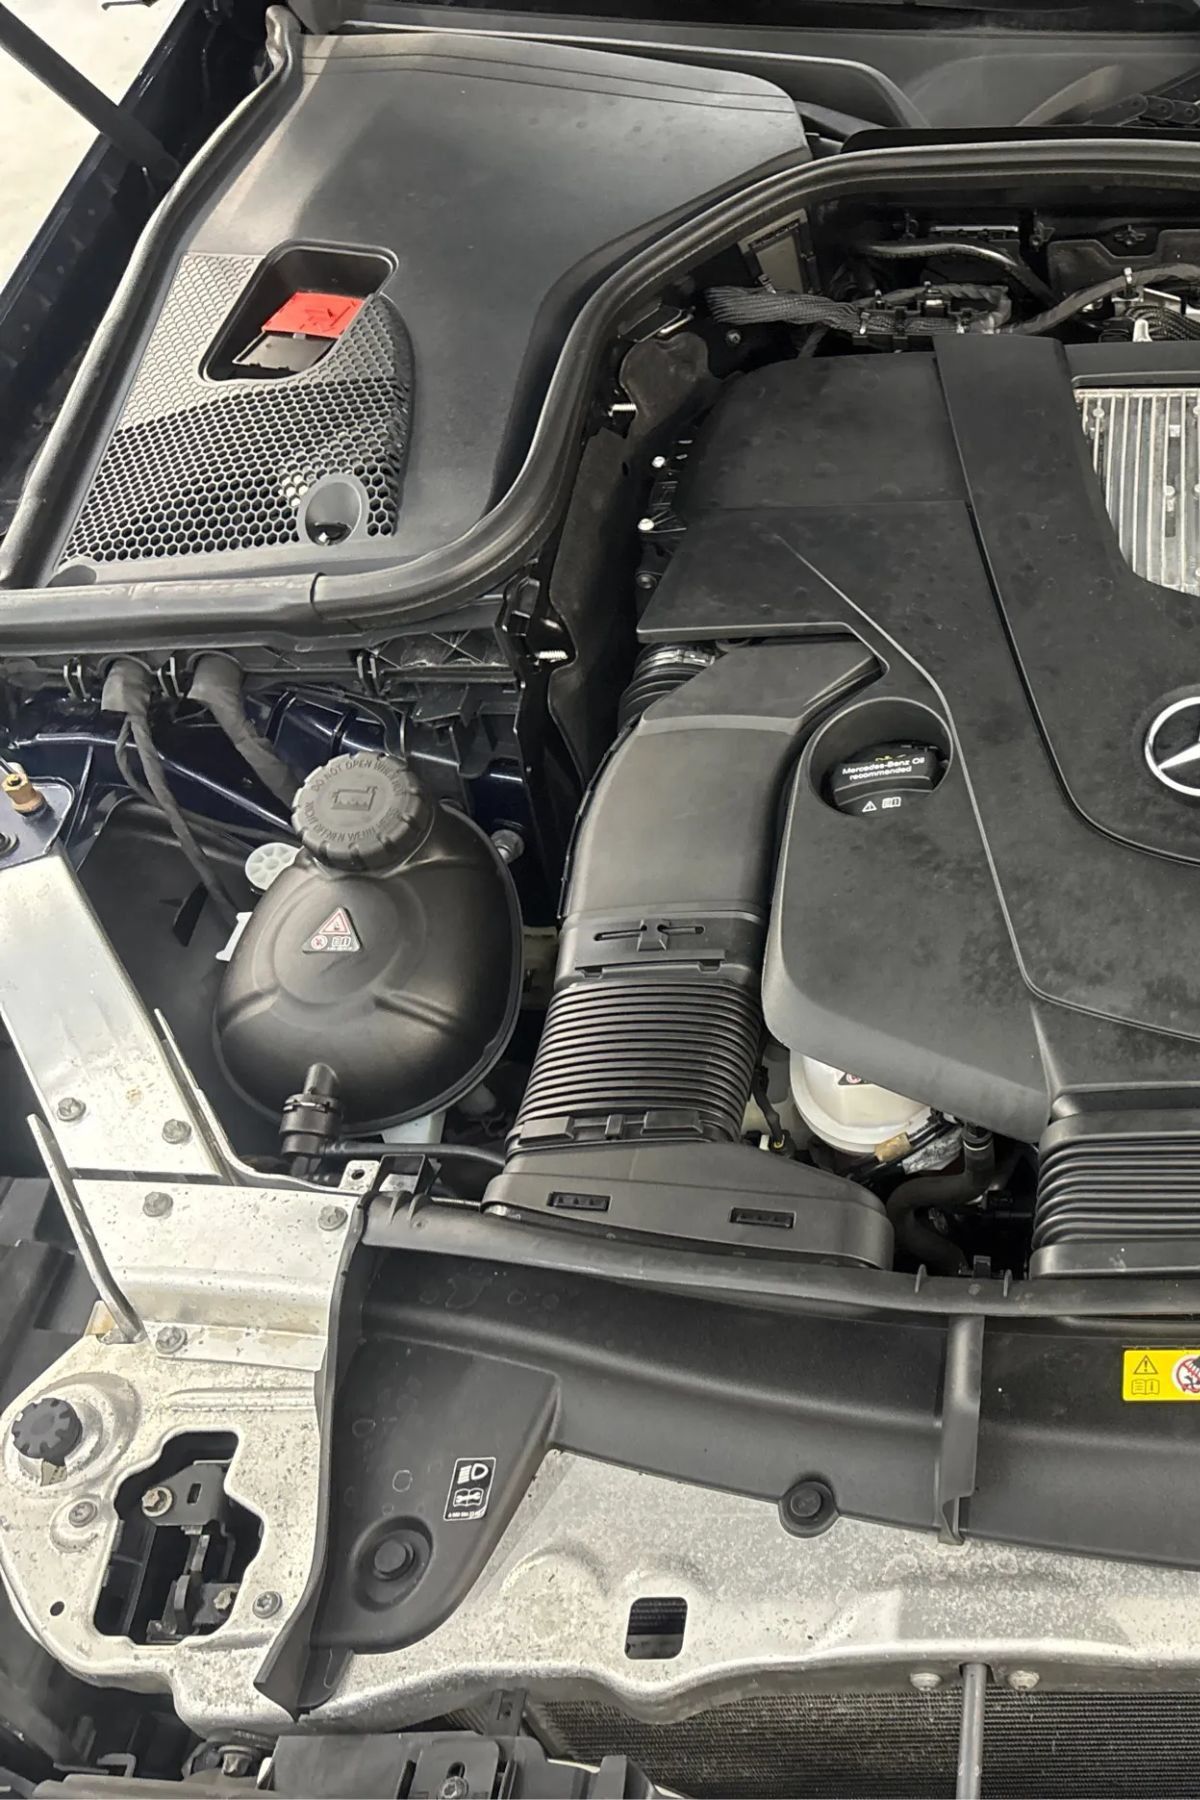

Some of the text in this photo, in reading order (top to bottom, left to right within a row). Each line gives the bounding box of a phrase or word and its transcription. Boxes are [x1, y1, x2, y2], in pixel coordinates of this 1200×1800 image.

[842, 757, 925, 775] Mercedes-Benz Oil
[849, 765, 912, 781] recommended
[310, 778, 325, 793] DO
[325, 765, 343, 781] NOT
[345, 759, 373, 769] OPEN
